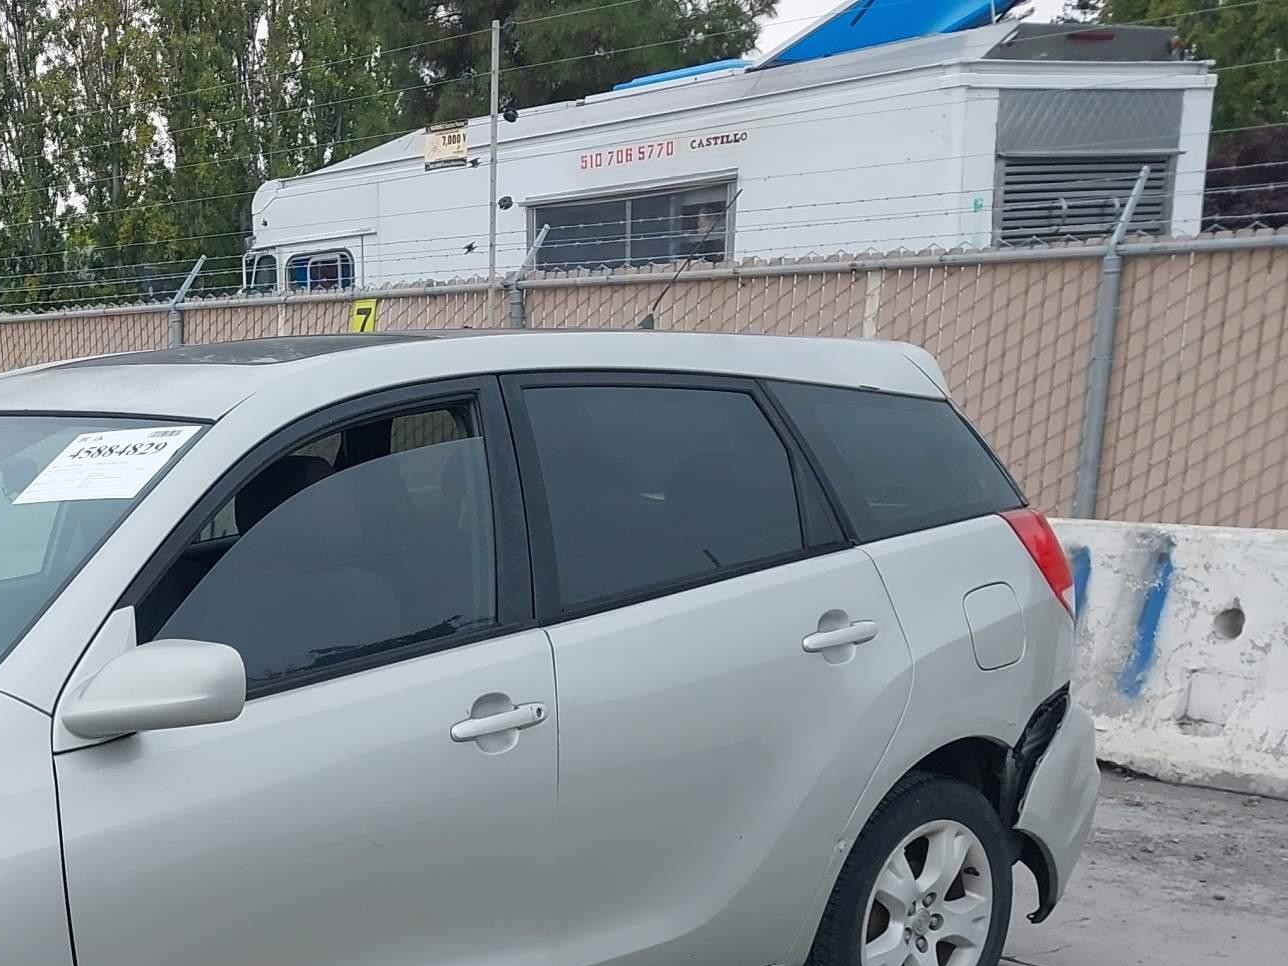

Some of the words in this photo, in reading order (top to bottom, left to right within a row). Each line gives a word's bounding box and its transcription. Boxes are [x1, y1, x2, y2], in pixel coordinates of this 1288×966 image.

[441, 133, 462, 148] 7,000
[689, 131, 749, 151] CASTILLO
[580, 152, 603, 170] 510
[607, 147, 633, 166] 706
[638, 140, 674, 161] 5770
[356, 306, 373, 333] 7
[68, 441, 168, 460] 45884829
